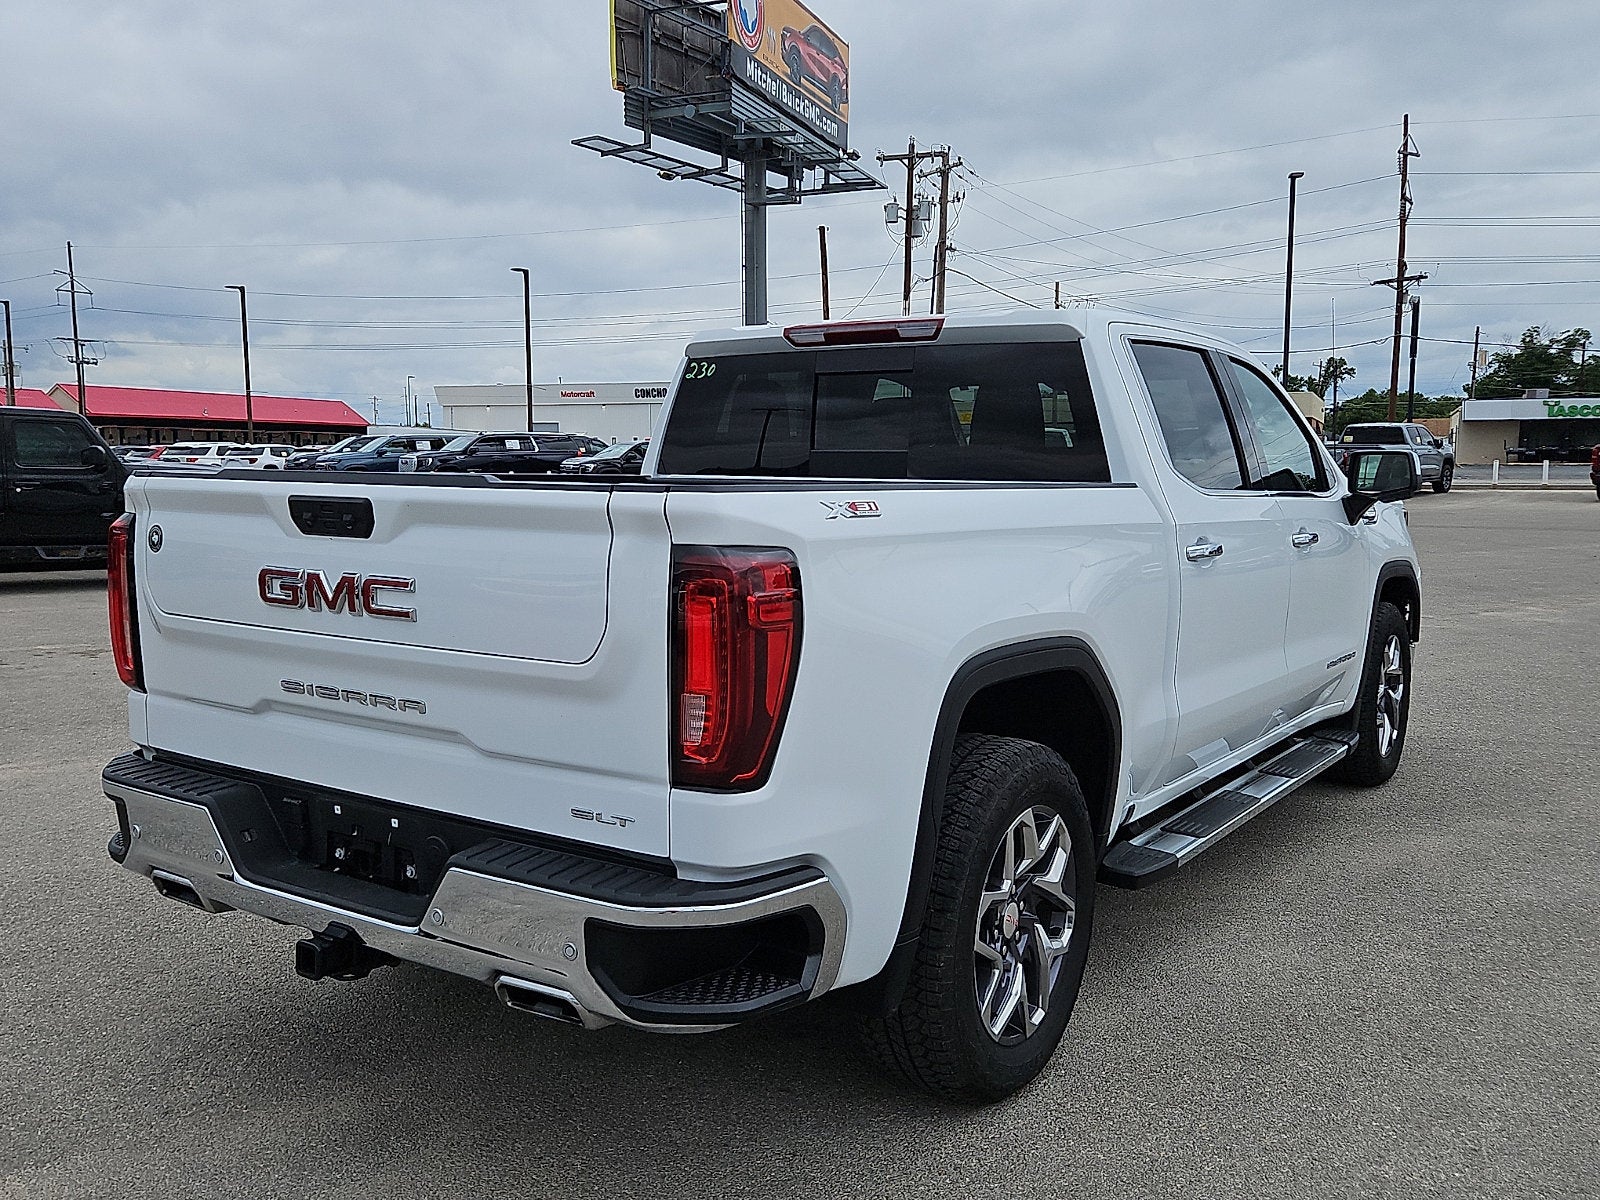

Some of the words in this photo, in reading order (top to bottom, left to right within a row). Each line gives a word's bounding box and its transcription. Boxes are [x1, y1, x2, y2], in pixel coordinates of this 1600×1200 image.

[746, 56, 838, 138] MitchellBuickGMC.com
[685, 362, 716, 379] 230
[560, 390, 595, 398] Motorcraft
[634, 387, 667, 399] CONCHO
[258, 565, 417, 622] GMC
[280, 679, 427, 714] SIERRA
[570, 807, 635, 828] SLT
